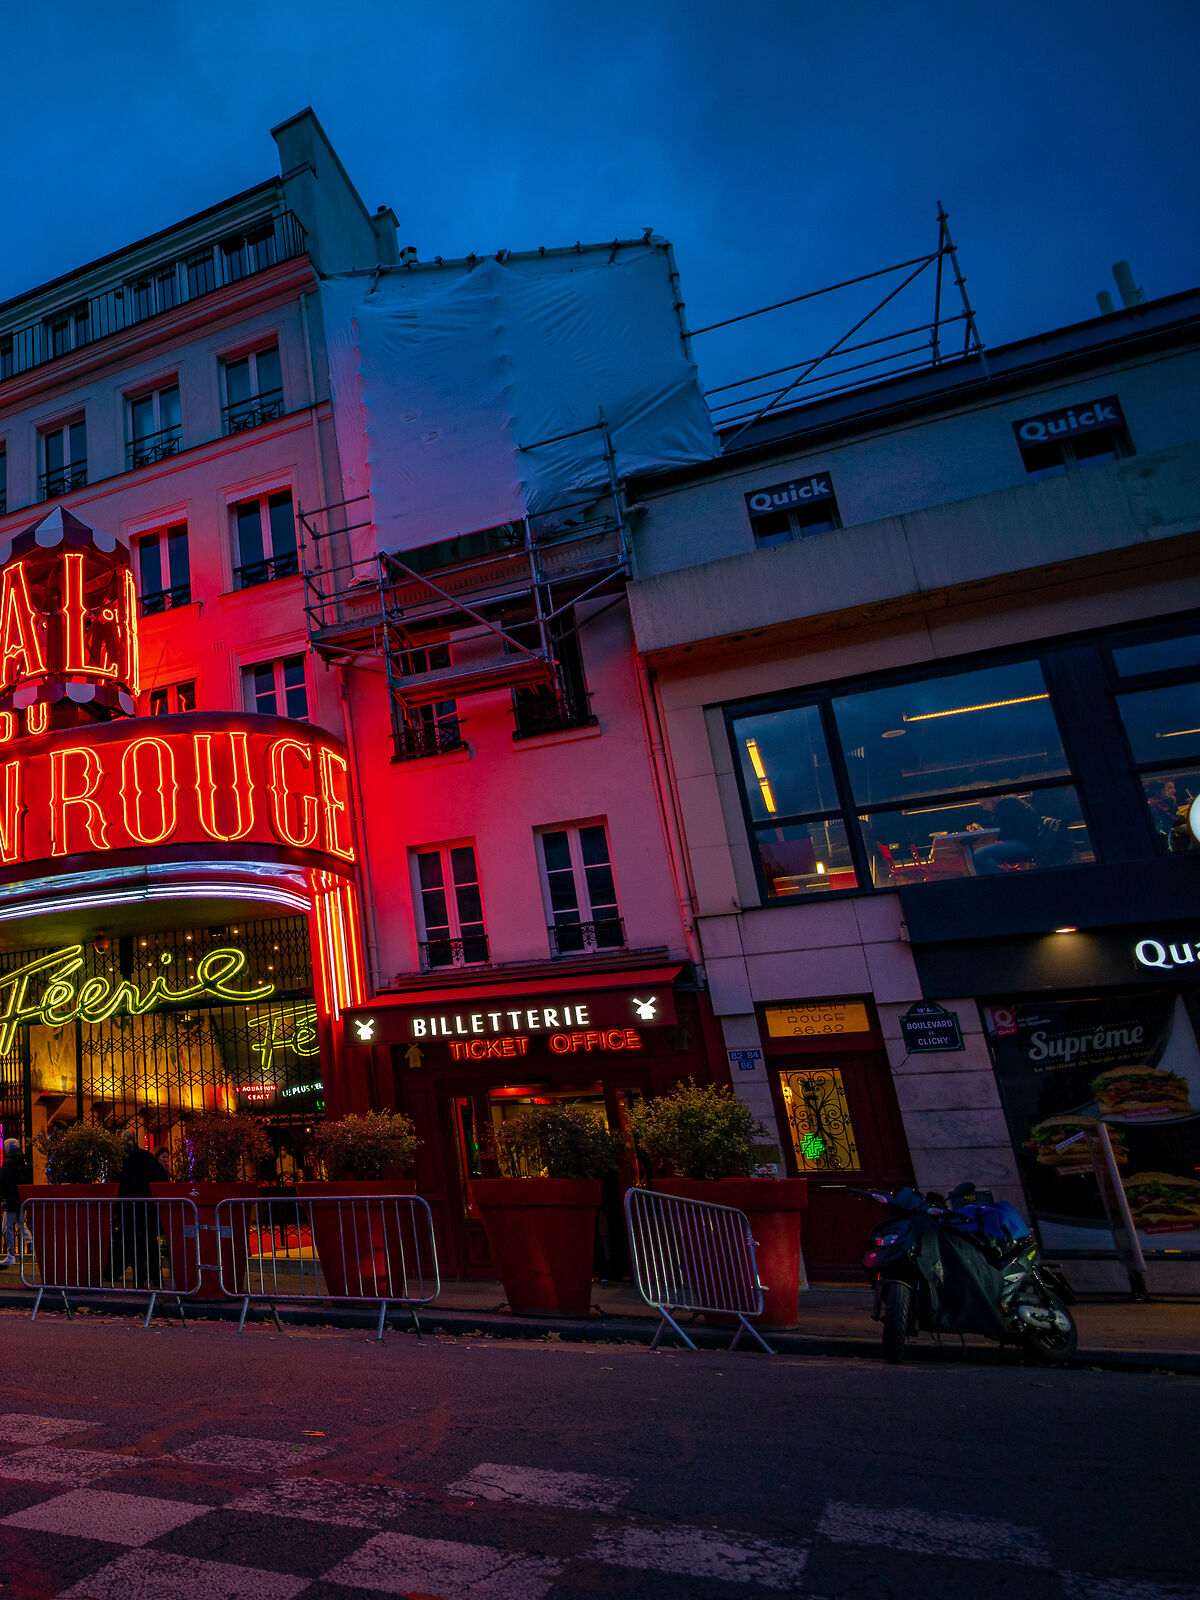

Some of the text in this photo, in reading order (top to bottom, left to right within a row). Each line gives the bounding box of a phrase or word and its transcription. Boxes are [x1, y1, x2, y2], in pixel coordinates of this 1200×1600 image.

[1018, 400, 1117, 443] Quick
[749, 478, 830, 513] Quick
[50, 732, 355, 862] ROUGE
[412, 1005, 590, 1038] BILLETTERIE
[787, 1013, 845, 1023] ROUGE
[793, 1023, 844, 1035] 86.82
[906, 1020, 953, 1030] BOULEVARD
[449, 1029, 642, 1061] TICKET OFFICE
[918, 1037, 948, 1046] CLICHY
[1028, 1026, 1145, 1062] Suprême
[730, 1051, 759, 1060] 82 84
[740, 1061, 753, 1070] 86
